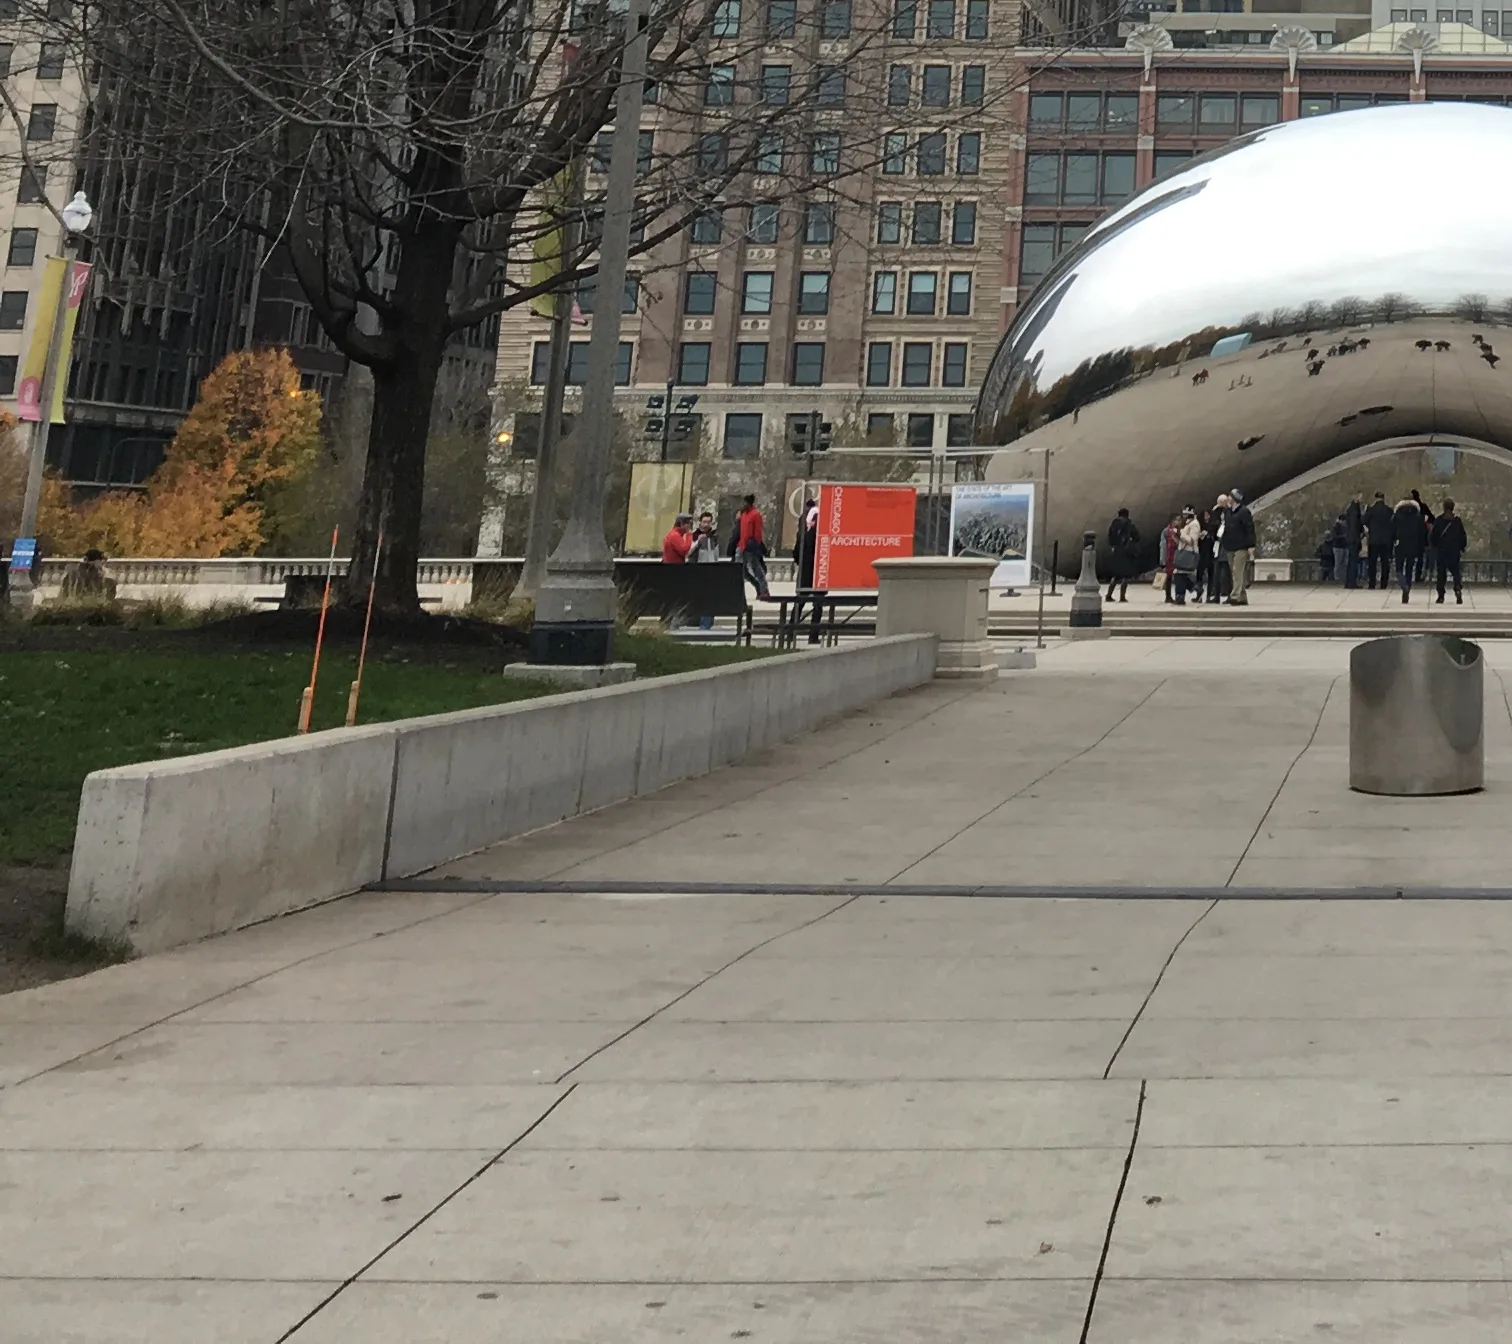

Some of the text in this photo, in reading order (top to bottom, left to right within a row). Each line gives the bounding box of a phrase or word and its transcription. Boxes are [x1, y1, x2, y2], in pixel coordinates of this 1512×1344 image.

[832, 486, 843, 534] CHICAGO
[818, 537, 829, 588] BIENNIAL
[831, 537, 901, 547] ARCHITECTURE
